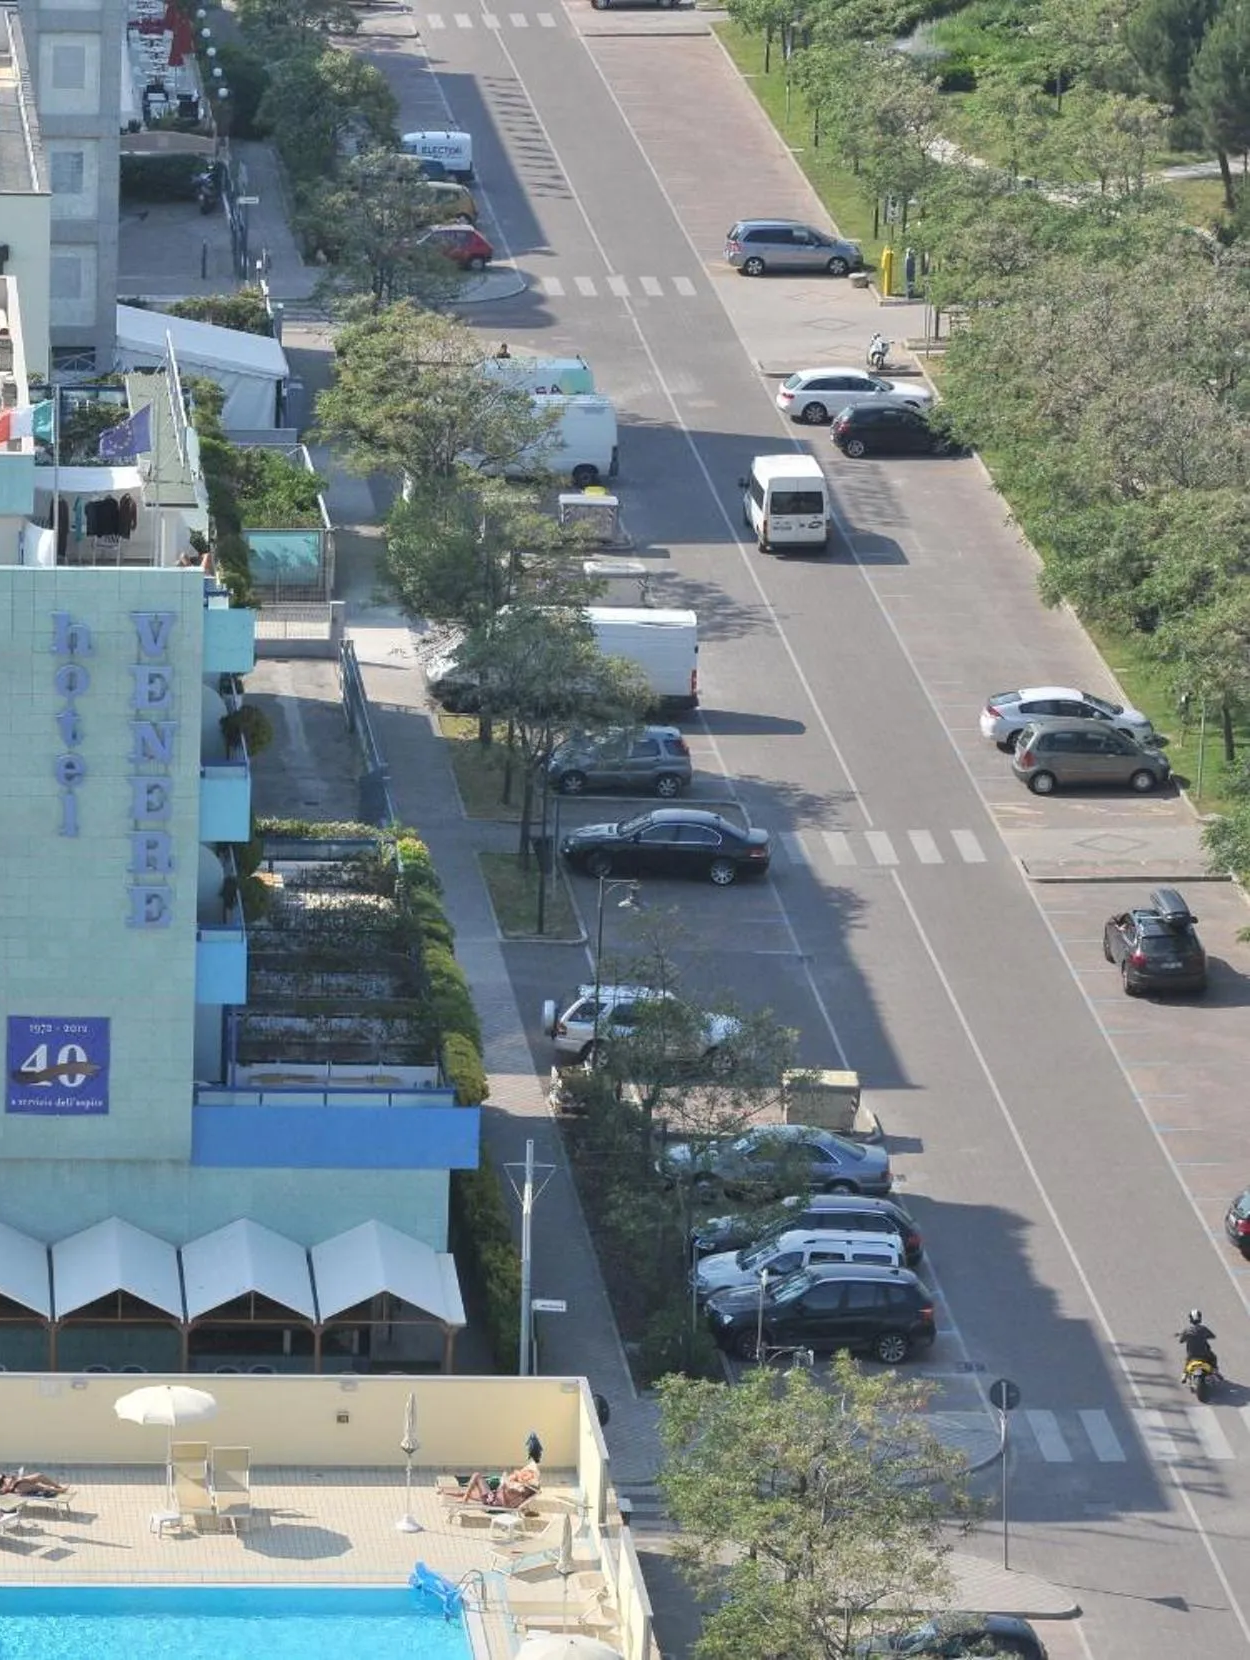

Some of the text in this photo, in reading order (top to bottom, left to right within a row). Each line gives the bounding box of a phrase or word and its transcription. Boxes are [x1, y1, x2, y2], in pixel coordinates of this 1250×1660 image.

[50, 609, 94, 838] hotel
[125, 611, 179, 929] VENERE
[20, 1043, 89, 1088] 40
